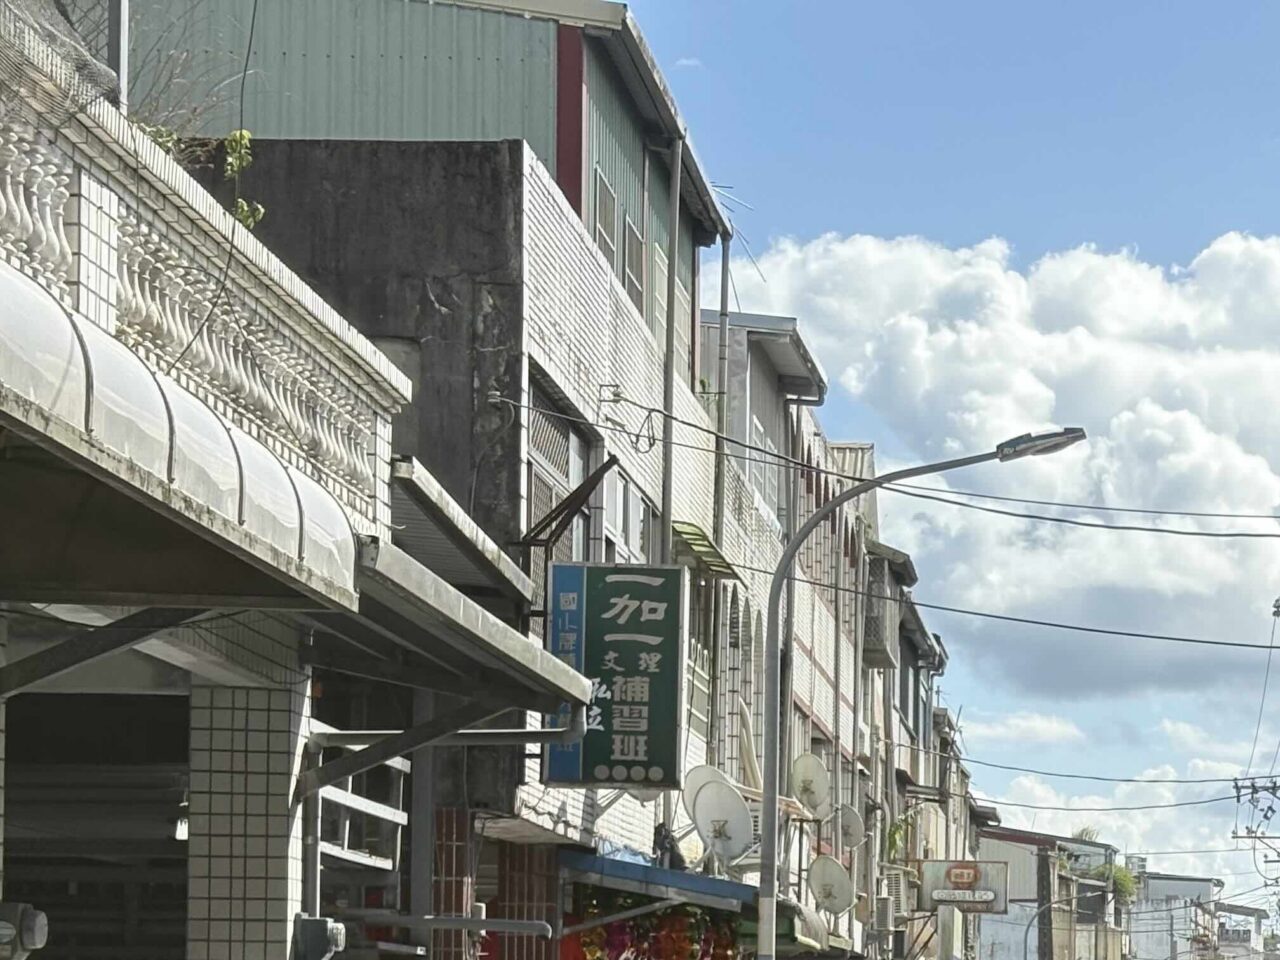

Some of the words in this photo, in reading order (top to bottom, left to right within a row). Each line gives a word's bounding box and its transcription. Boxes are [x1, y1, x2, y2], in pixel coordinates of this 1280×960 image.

[601, 573, 668, 646] 一加一
[601, 650, 663, 672] 文理
[610, 676, 650, 762] 補習班
